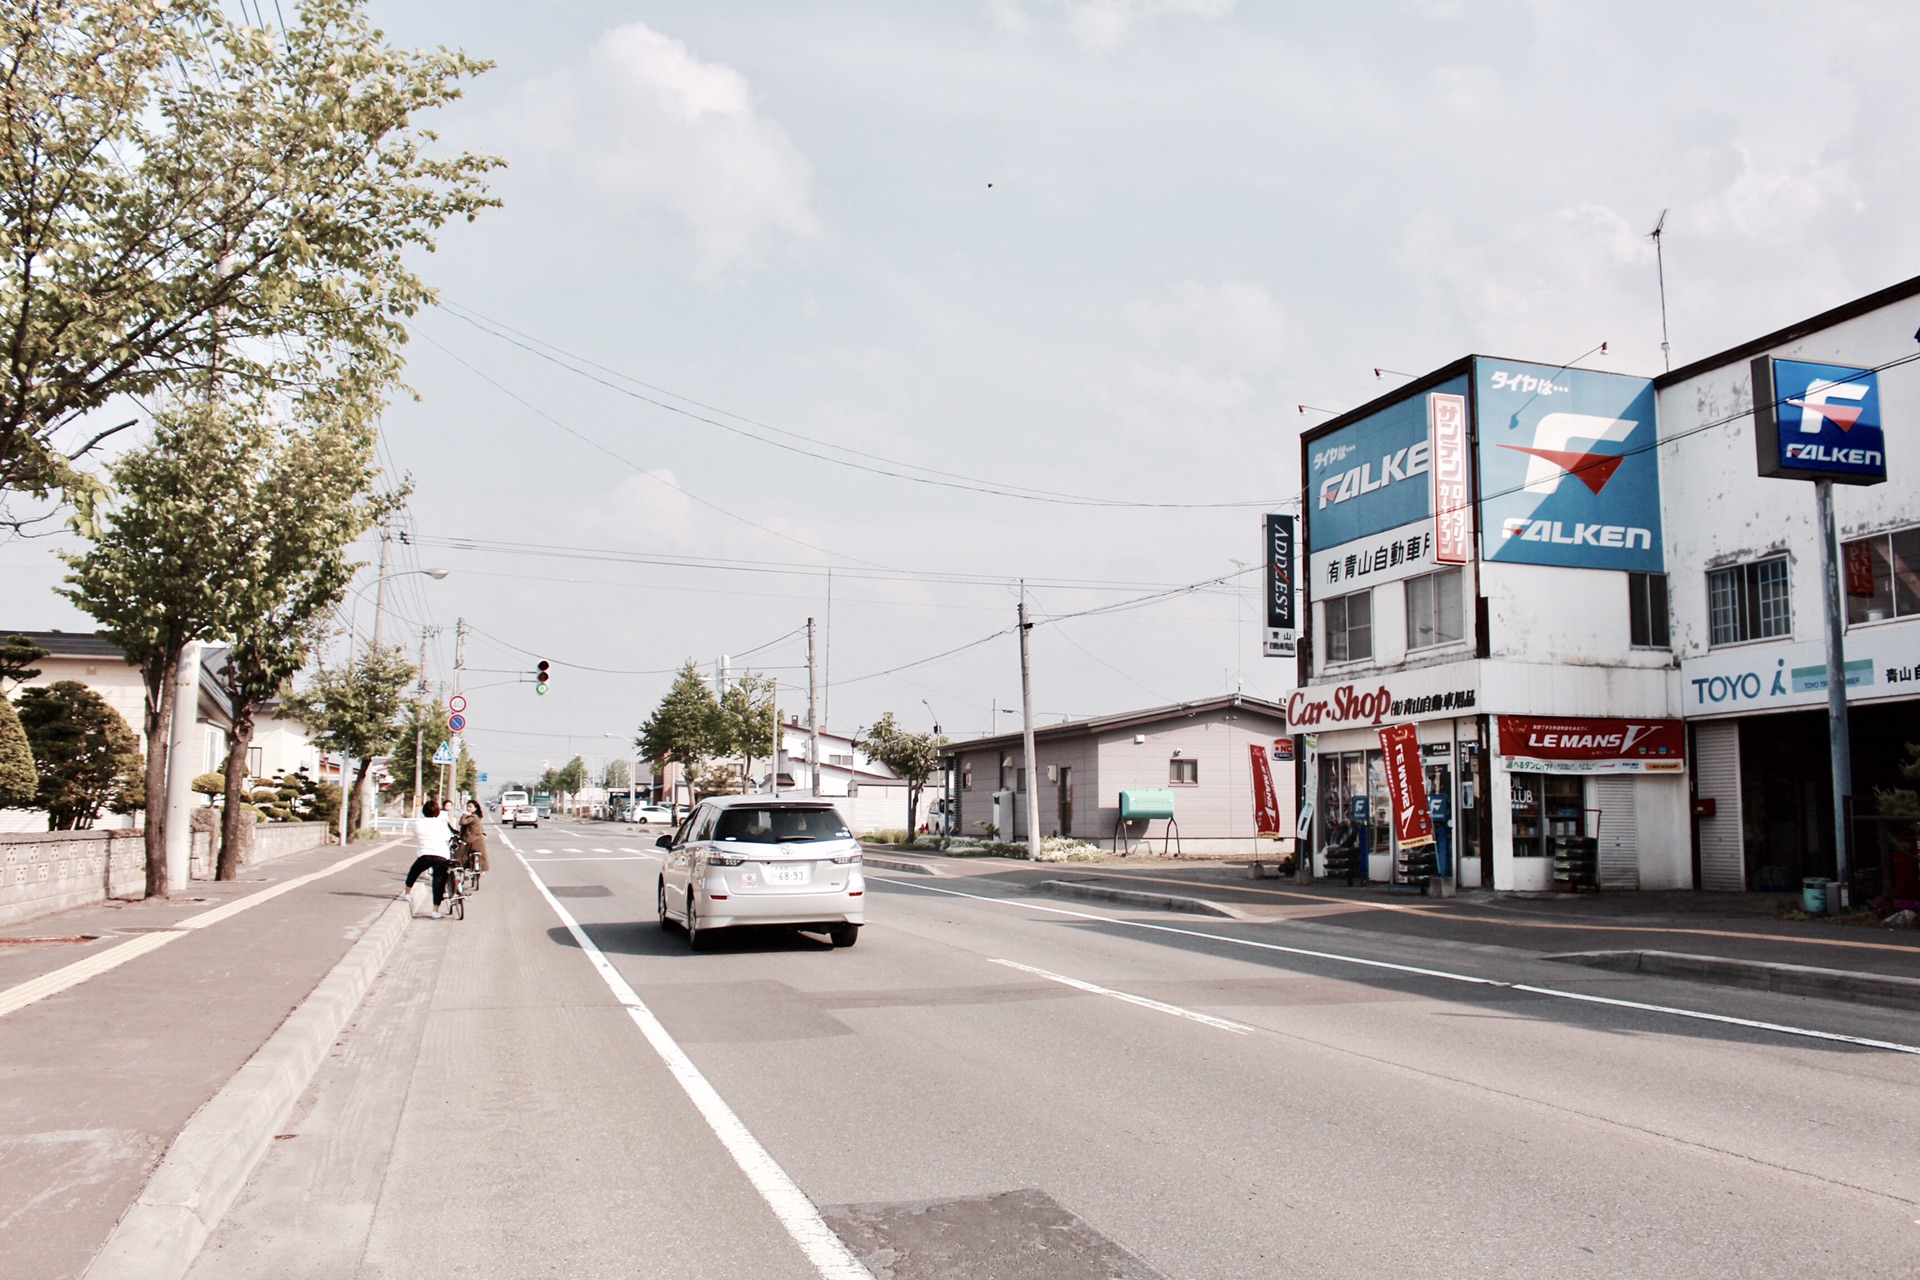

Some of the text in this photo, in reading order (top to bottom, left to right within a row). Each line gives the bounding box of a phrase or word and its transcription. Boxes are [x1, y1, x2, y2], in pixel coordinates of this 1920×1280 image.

[1439, 405, 1460, 479] サンデン
[1786, 443, 1882, 466] FALKEN
[1318, 440, 1429, 511] FALKE
[1452, 484, 1465, 556] ロータリー
[1501, 517, 1652, 550] FALKEN
[1274, 524, 1289, 620] ADDZEST
[1691, 672, 1761, 704] TOYO
[1528, 725, 1664, 754] LE MANS V
[1510, 790, 1534, 803] LUB
